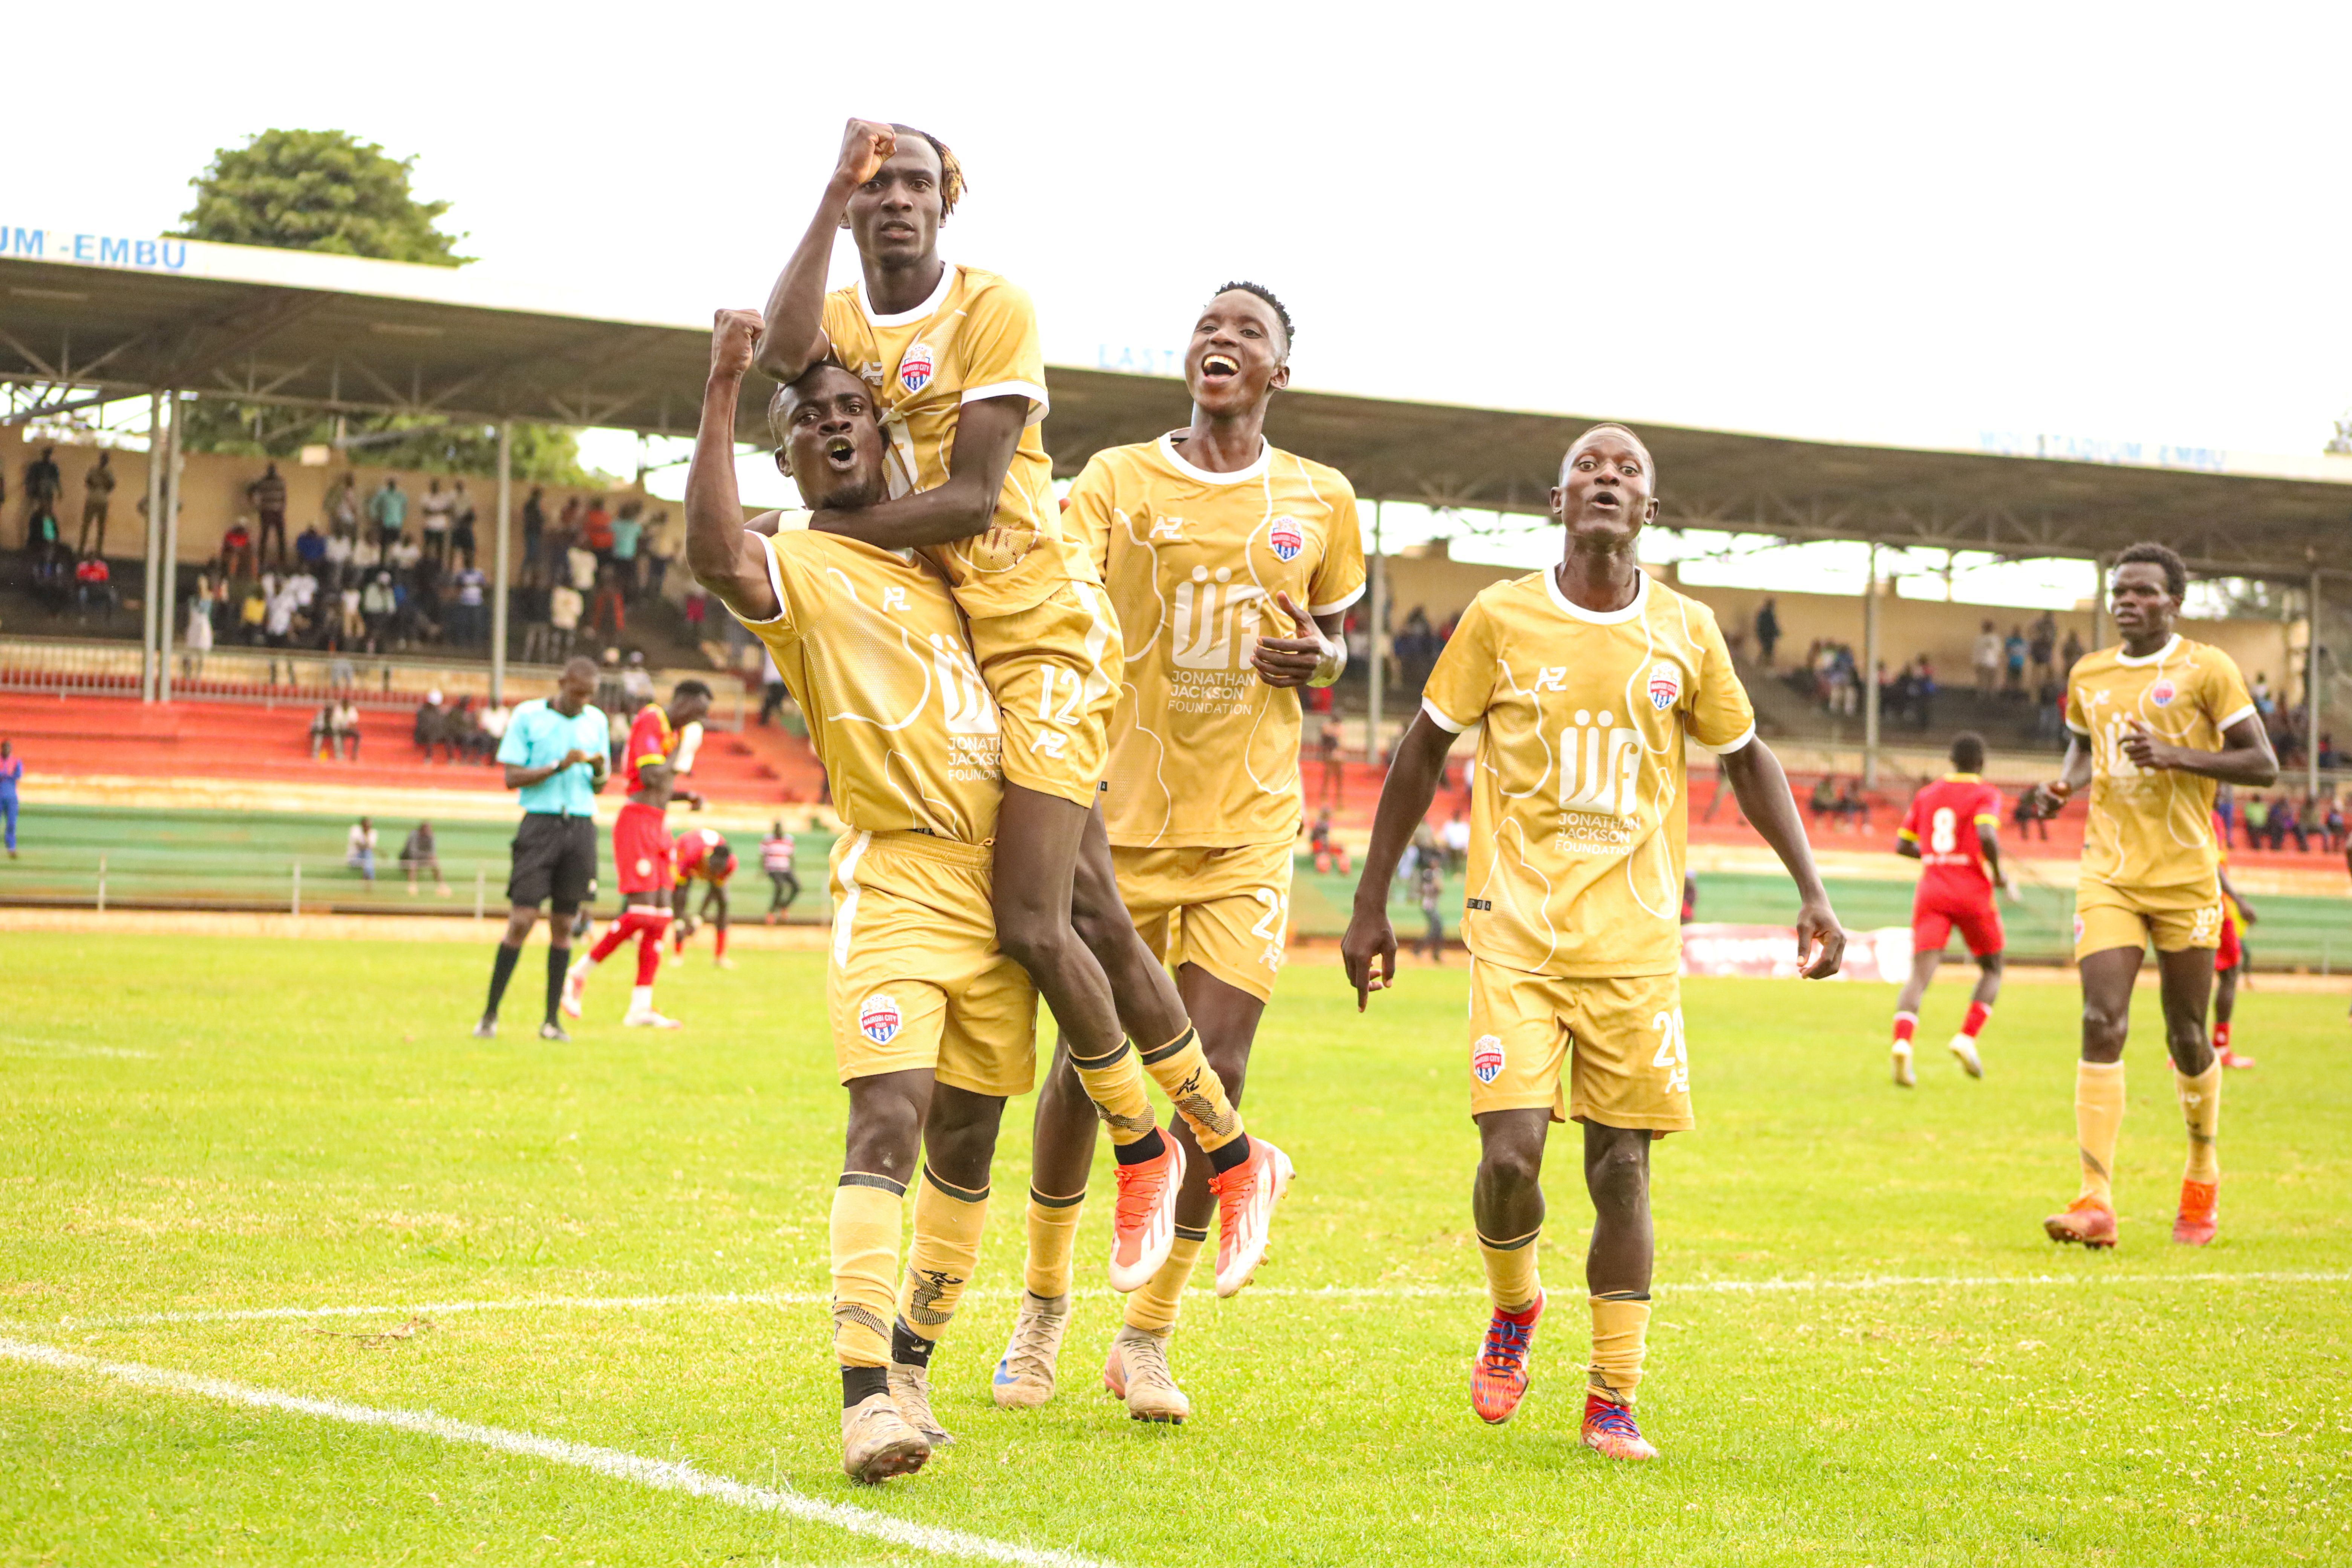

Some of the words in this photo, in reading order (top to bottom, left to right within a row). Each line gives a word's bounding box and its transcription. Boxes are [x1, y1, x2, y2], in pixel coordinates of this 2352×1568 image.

[903, 364, 919, 374] NAIROBI
[920, 364, 929, 372] CITY
[1149, 516, 1182, 539] AZ
[1171, 670, 1257, 687] JONATHAN
[1534, 666, 1566, 692] AZ
[1038, 664, 1083, 725] 12
[1170, 684, 1244, 700] JACKSON
[1168, 700, 1252, 715] FOUNDATION
[948, 769, 1003, 781] FOUNDAT
[1558, 813, 1641, 830] JONATHAN
[1931, 807, 1957, 853] 8
[1557, 827, 1630, 844] JACKSON
[864, 1014, 884, 1026] NAIROBI
